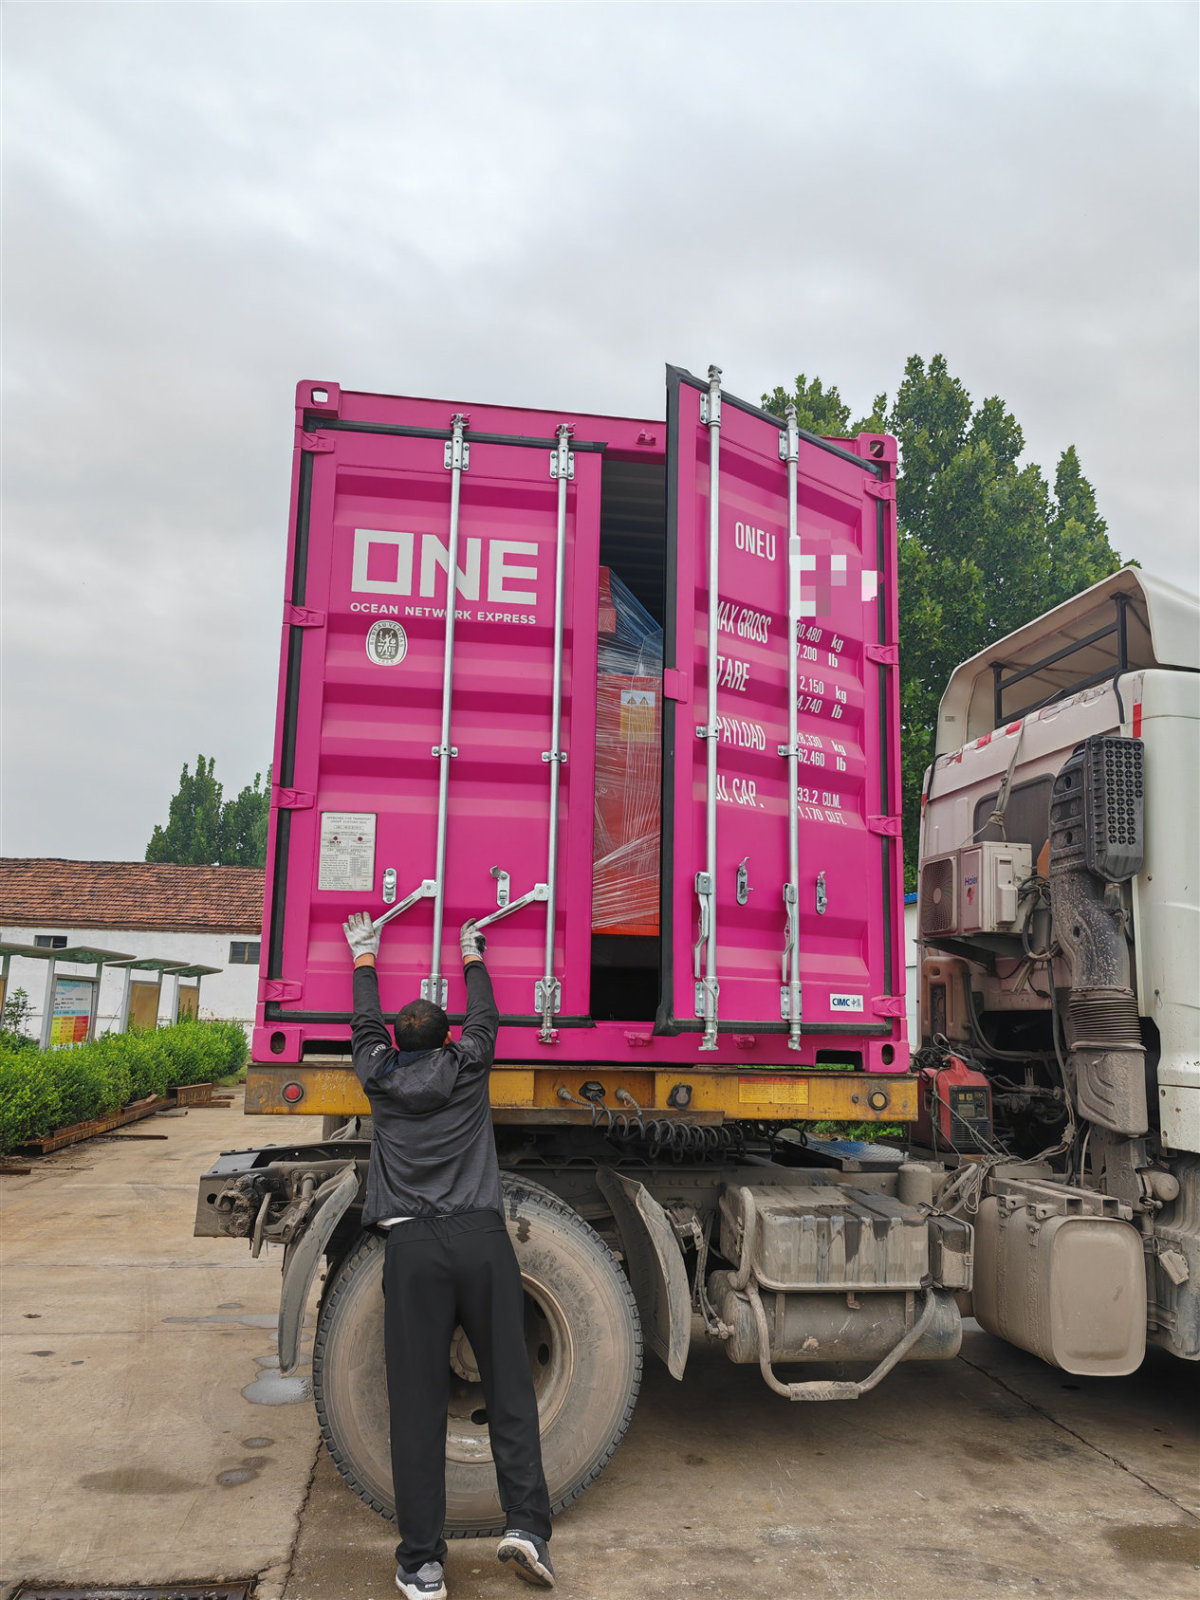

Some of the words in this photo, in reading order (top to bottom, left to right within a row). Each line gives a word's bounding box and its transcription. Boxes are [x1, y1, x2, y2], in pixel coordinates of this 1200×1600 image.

[735, 521, 776, 562] ONEU
[351, 528, 539, 605] ONE
[350, 602, 399, 614] OCEAN
[477, 611, 537, 625] EXPRESS
[737, 608, 772, 644] GROSS
[831, 633, 845, 653] kg
[797, 642, 817, 661] 7,200
[828, 652, 838, 668] lb
[717, 655, 750, 692] TARE
[799, 675, 824, 695] 2,150
[835, 685, 847, 704] kg
[831, 703, 843, 719] lb
[717, 716, 766, 751] PAYLOAD
[797, 732, 823, 748] 8,330
[831, 739, 847, 756] kg
[798, 748, 825, 767] 62,460
[836, 755, 846, 771] lb
[797, 787, 818, 805] 33.2
[832, 998, 850, 1006] CIMC
